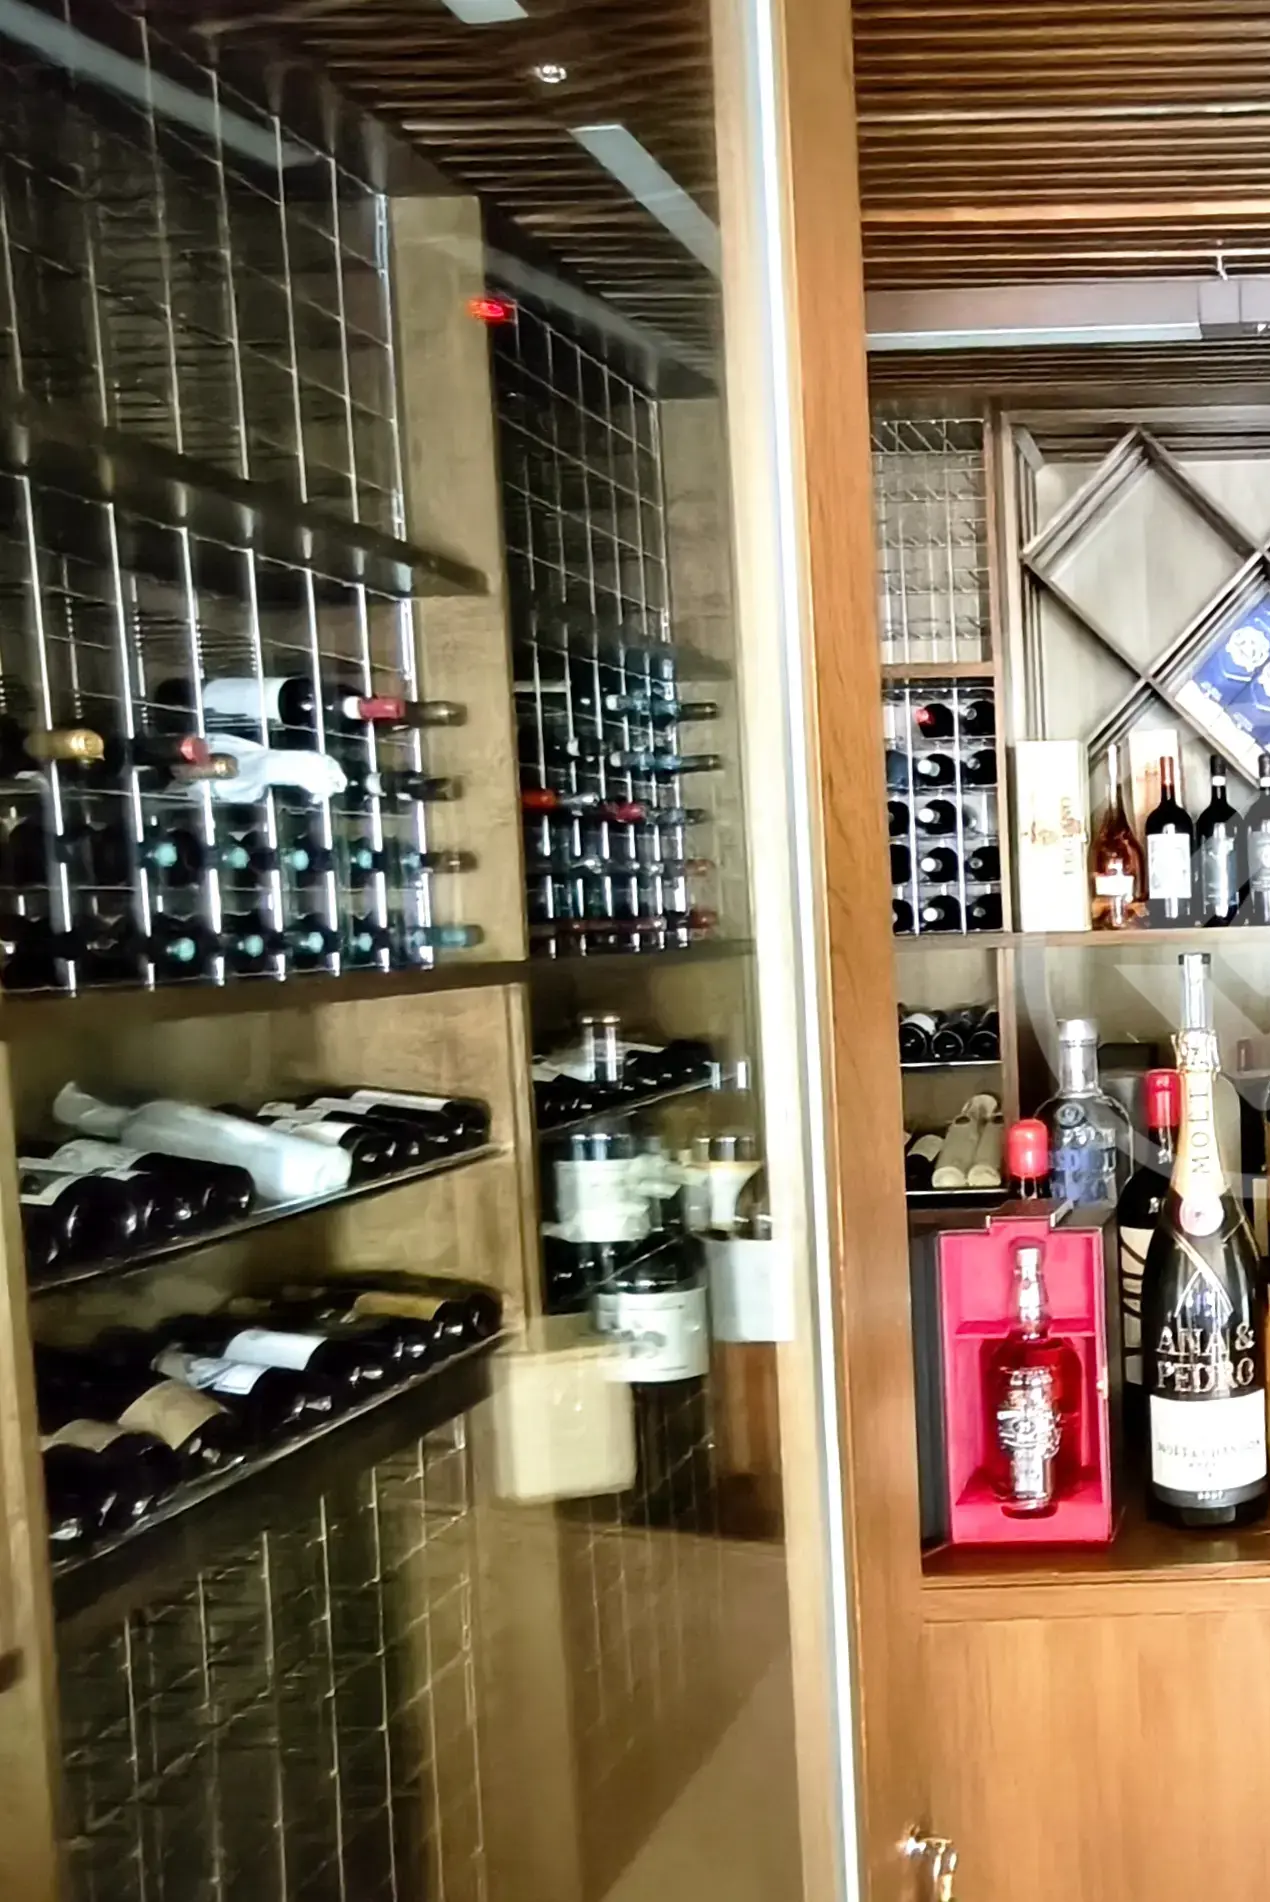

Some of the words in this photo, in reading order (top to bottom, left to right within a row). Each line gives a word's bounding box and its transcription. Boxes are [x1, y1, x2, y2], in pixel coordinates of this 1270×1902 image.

[1155, 1325, 1230, 1356] ANA
[1234, 1322, 1256, 1351] &
[1157, 1356, 1255, 1393] PEDRO
